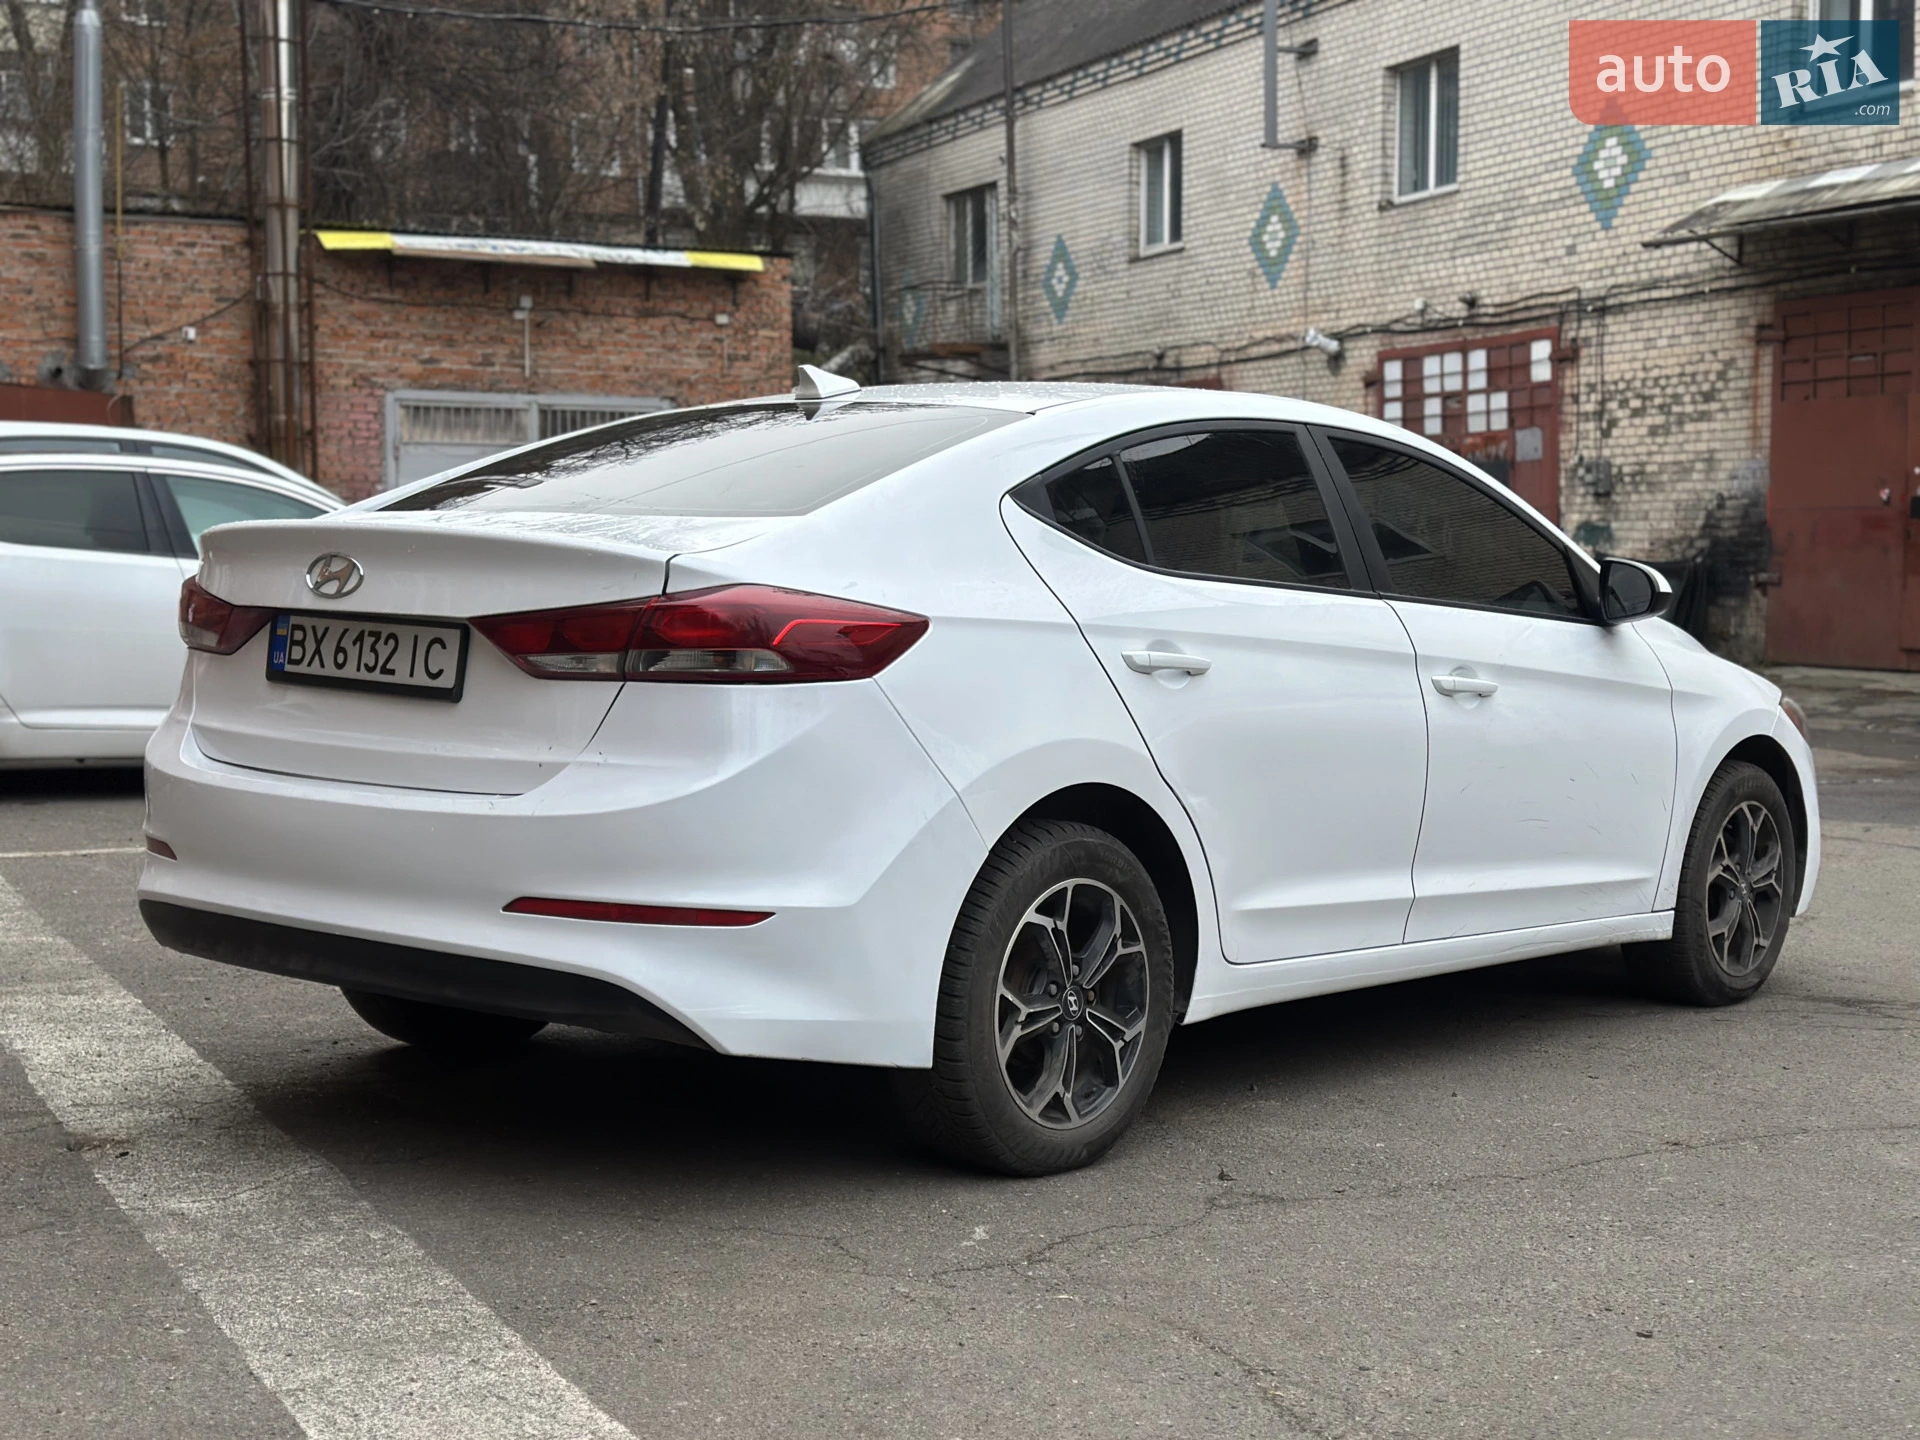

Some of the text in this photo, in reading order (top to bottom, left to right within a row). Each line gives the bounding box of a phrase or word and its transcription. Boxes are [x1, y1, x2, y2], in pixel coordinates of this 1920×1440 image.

[273, 651, 285, 664] UA
[287, 624, 447, 680] BX 6132 IC
